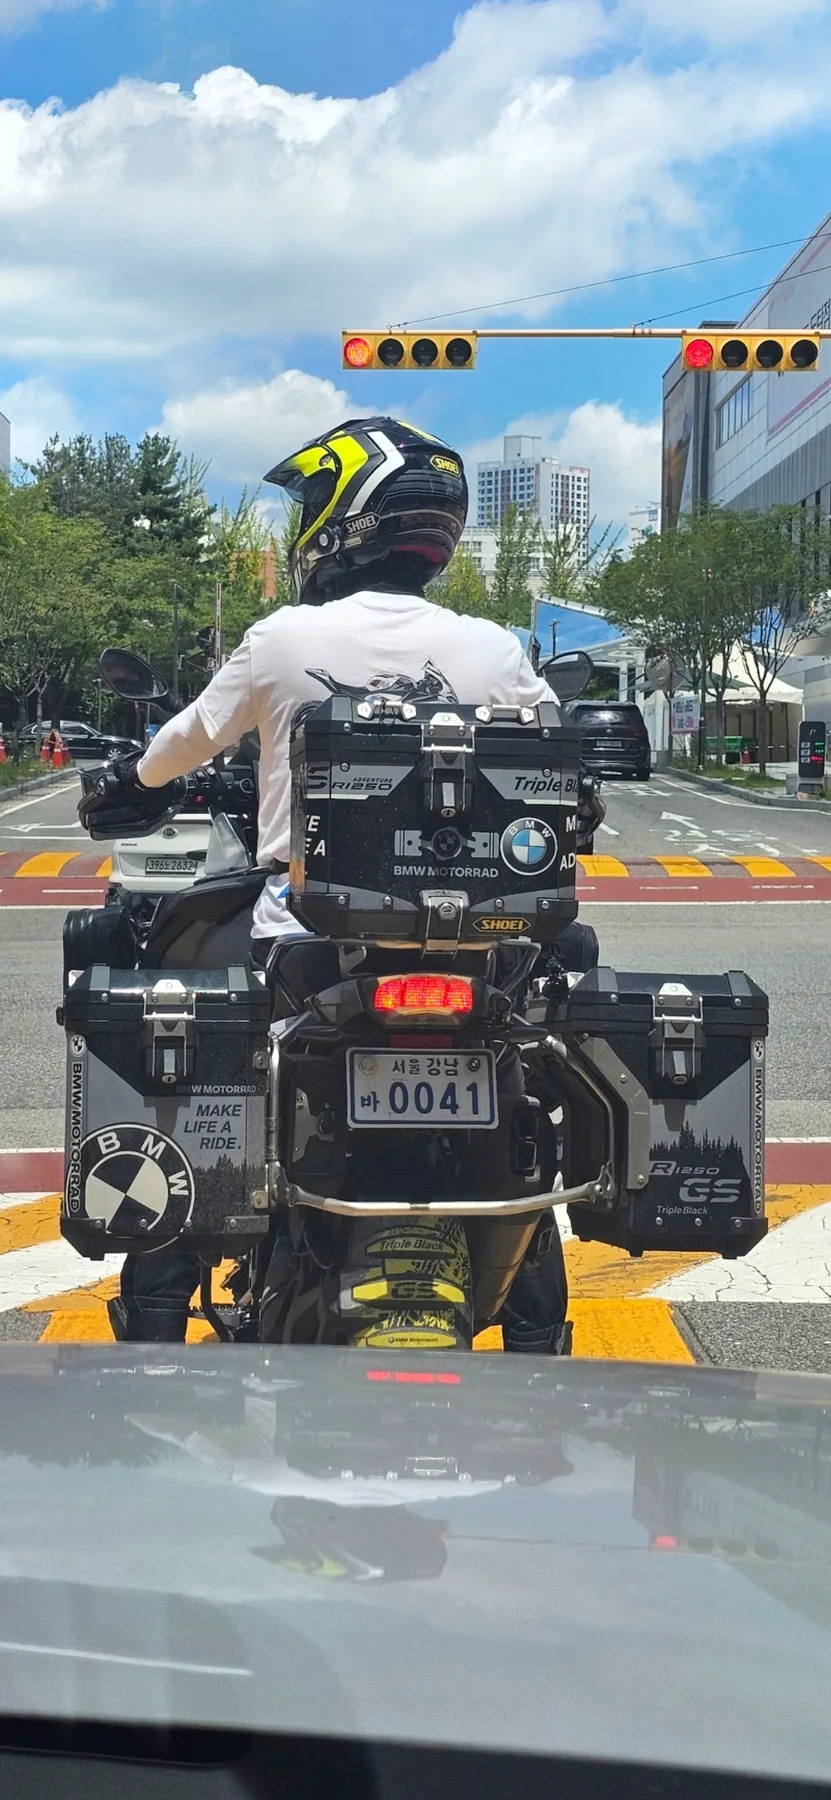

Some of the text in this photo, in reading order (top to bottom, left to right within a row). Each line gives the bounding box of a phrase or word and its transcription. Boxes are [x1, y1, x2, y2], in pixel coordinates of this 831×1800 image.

[435, 457, 459, 474] SHOEI
[346, 515, 376, 533] SHOEI
[514, 776, 561, 794] Triple
[508, 820, 551, 838] BMW
[171, 860, 193, 870] 2632
[394, 865, 498, 878] BMW MOTORRAD
[481, 919, 523, 930] SHOEI
[392, 1057, 459, 1076] 서울 강남
[203, 1085, 257, 1093] MOTORRAD
[360, 1081, 479, 1115] 바 0041
[196, 1104, 242, 1117] MAKE
[184, 1121, 231, 1133] LIFE A
[69, 1062, 83, 1213] BMW MOTORRAD
[200, 1137, 241, 1149] RIDE.
[754, 1067, 763, 1213] BMW MOTORRAD
[97, 1131, 189, 1196] BMW
[679, 1178, 742, 1203] GS
[657, 1205, 708, 1215] Triple Black
[381, 1240, 445, 1251] Triple Black
[391, 1282, 438, 1298] GS
